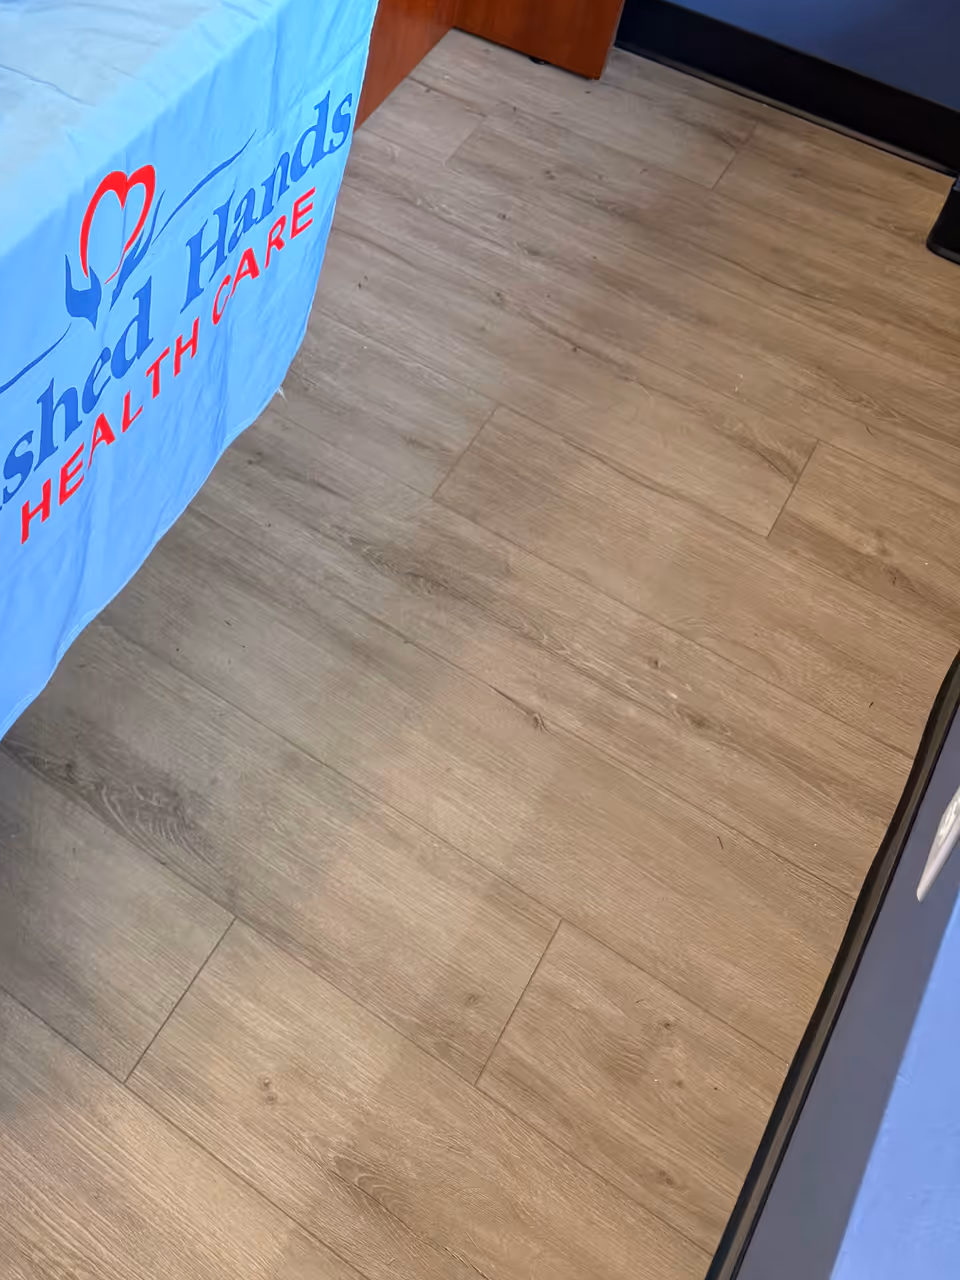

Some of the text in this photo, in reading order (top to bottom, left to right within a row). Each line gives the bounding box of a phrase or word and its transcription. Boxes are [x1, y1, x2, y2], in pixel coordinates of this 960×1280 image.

[180, 90, 354, 315] Hands
[20, 316, 200, 545] HEALTH
[212, 186, 318, 327] CARE
